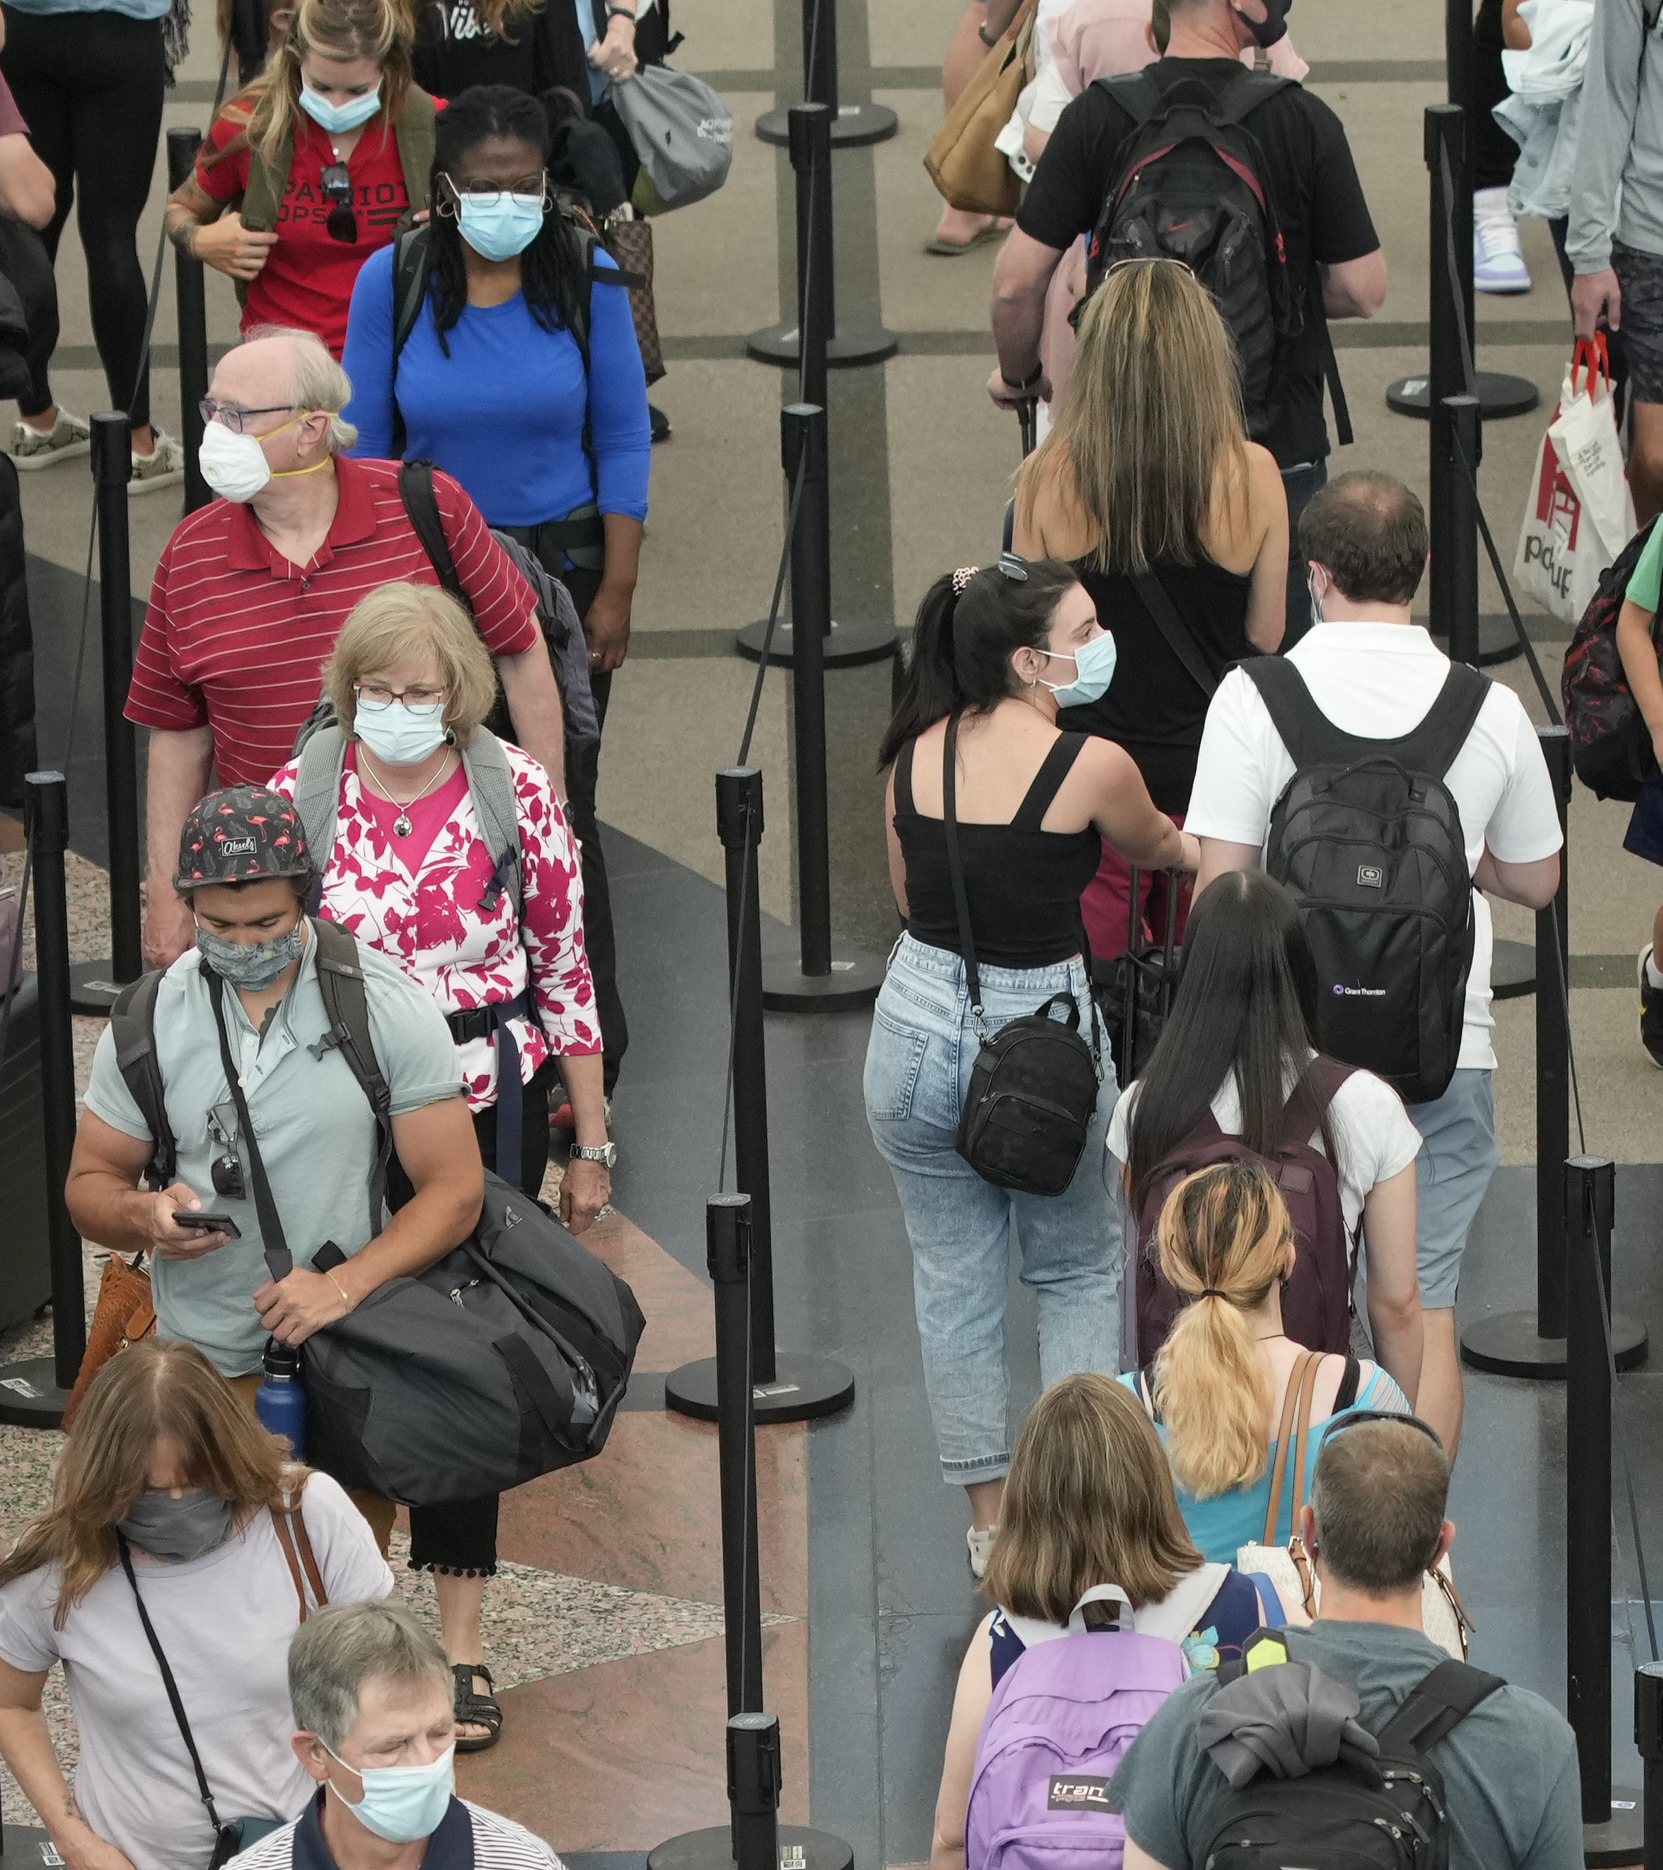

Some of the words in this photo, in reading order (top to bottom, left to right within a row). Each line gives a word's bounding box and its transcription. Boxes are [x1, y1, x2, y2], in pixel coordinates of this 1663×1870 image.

[1344, 986, 1361, 995] Grant
[1361, 987, 1386, 996] Thornton
[1053, 1782, 1105, 1797] tran
